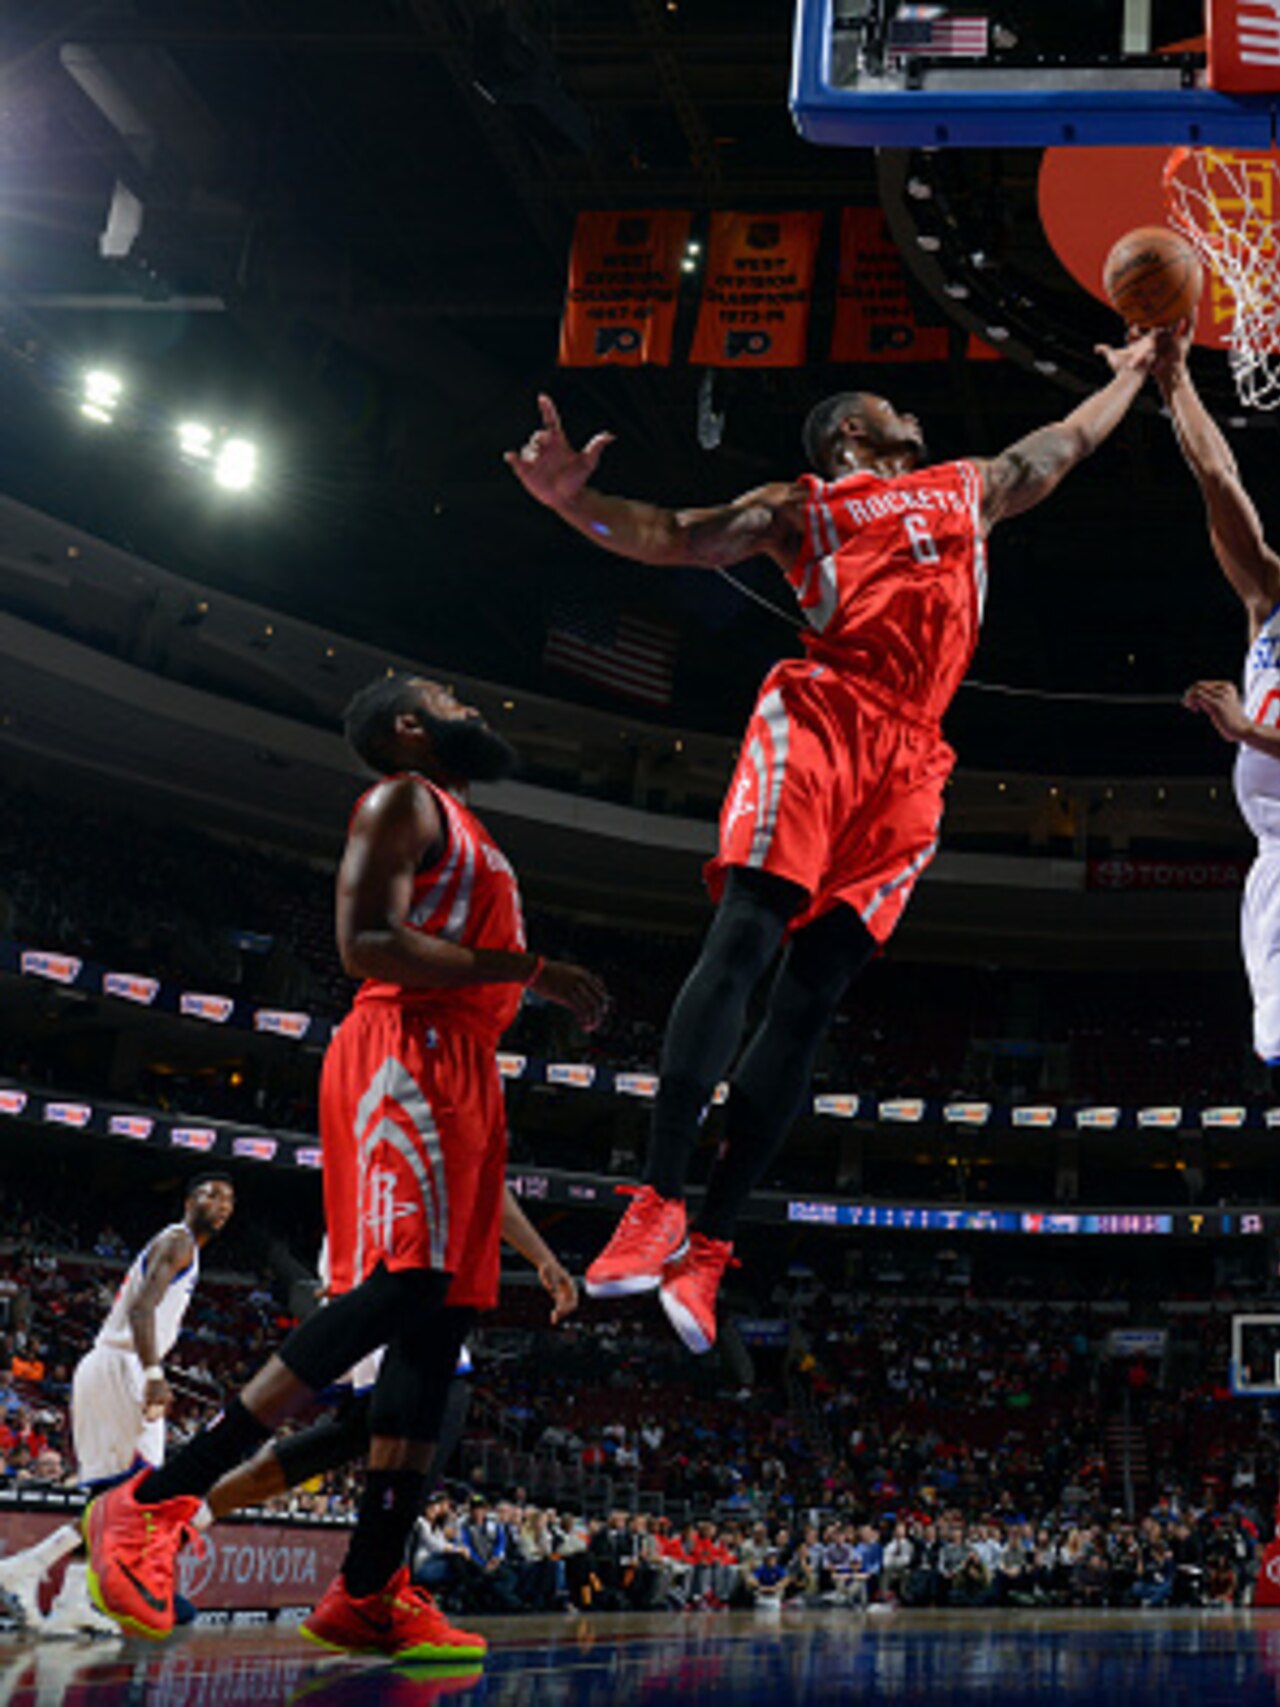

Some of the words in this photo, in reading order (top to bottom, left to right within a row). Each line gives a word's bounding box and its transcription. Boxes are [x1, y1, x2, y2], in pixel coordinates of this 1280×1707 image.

[843, 487, 967, 527] ROCKETS
[903, 512, 941, 565] 6
[1138, 864, 1240, 885] TOYOTA
[219, 1544, 318, 1585] TOYOTA
